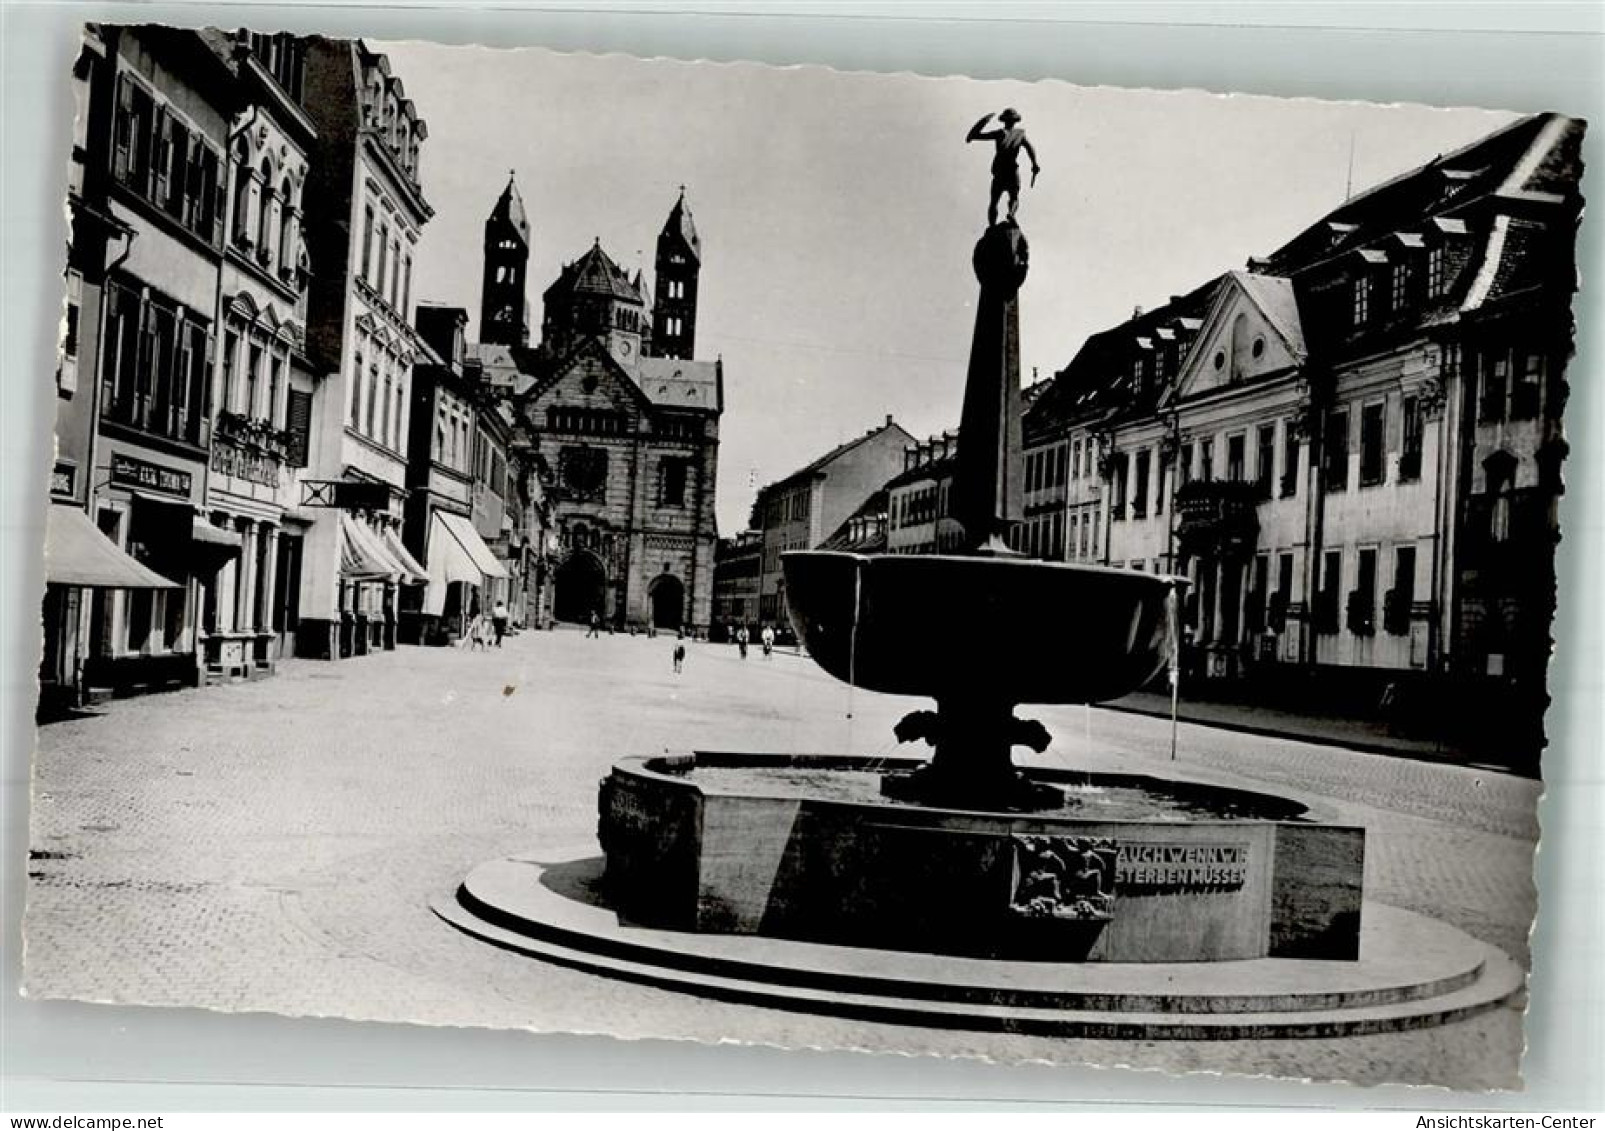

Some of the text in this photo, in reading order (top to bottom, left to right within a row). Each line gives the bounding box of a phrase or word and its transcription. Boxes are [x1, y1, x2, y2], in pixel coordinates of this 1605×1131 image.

[1116, 846, 1164, 864] AUCH
[1168, 847, 1218, 864] WENN
[1114, 865, 1246, 885] STERBEN MÜSSEN
